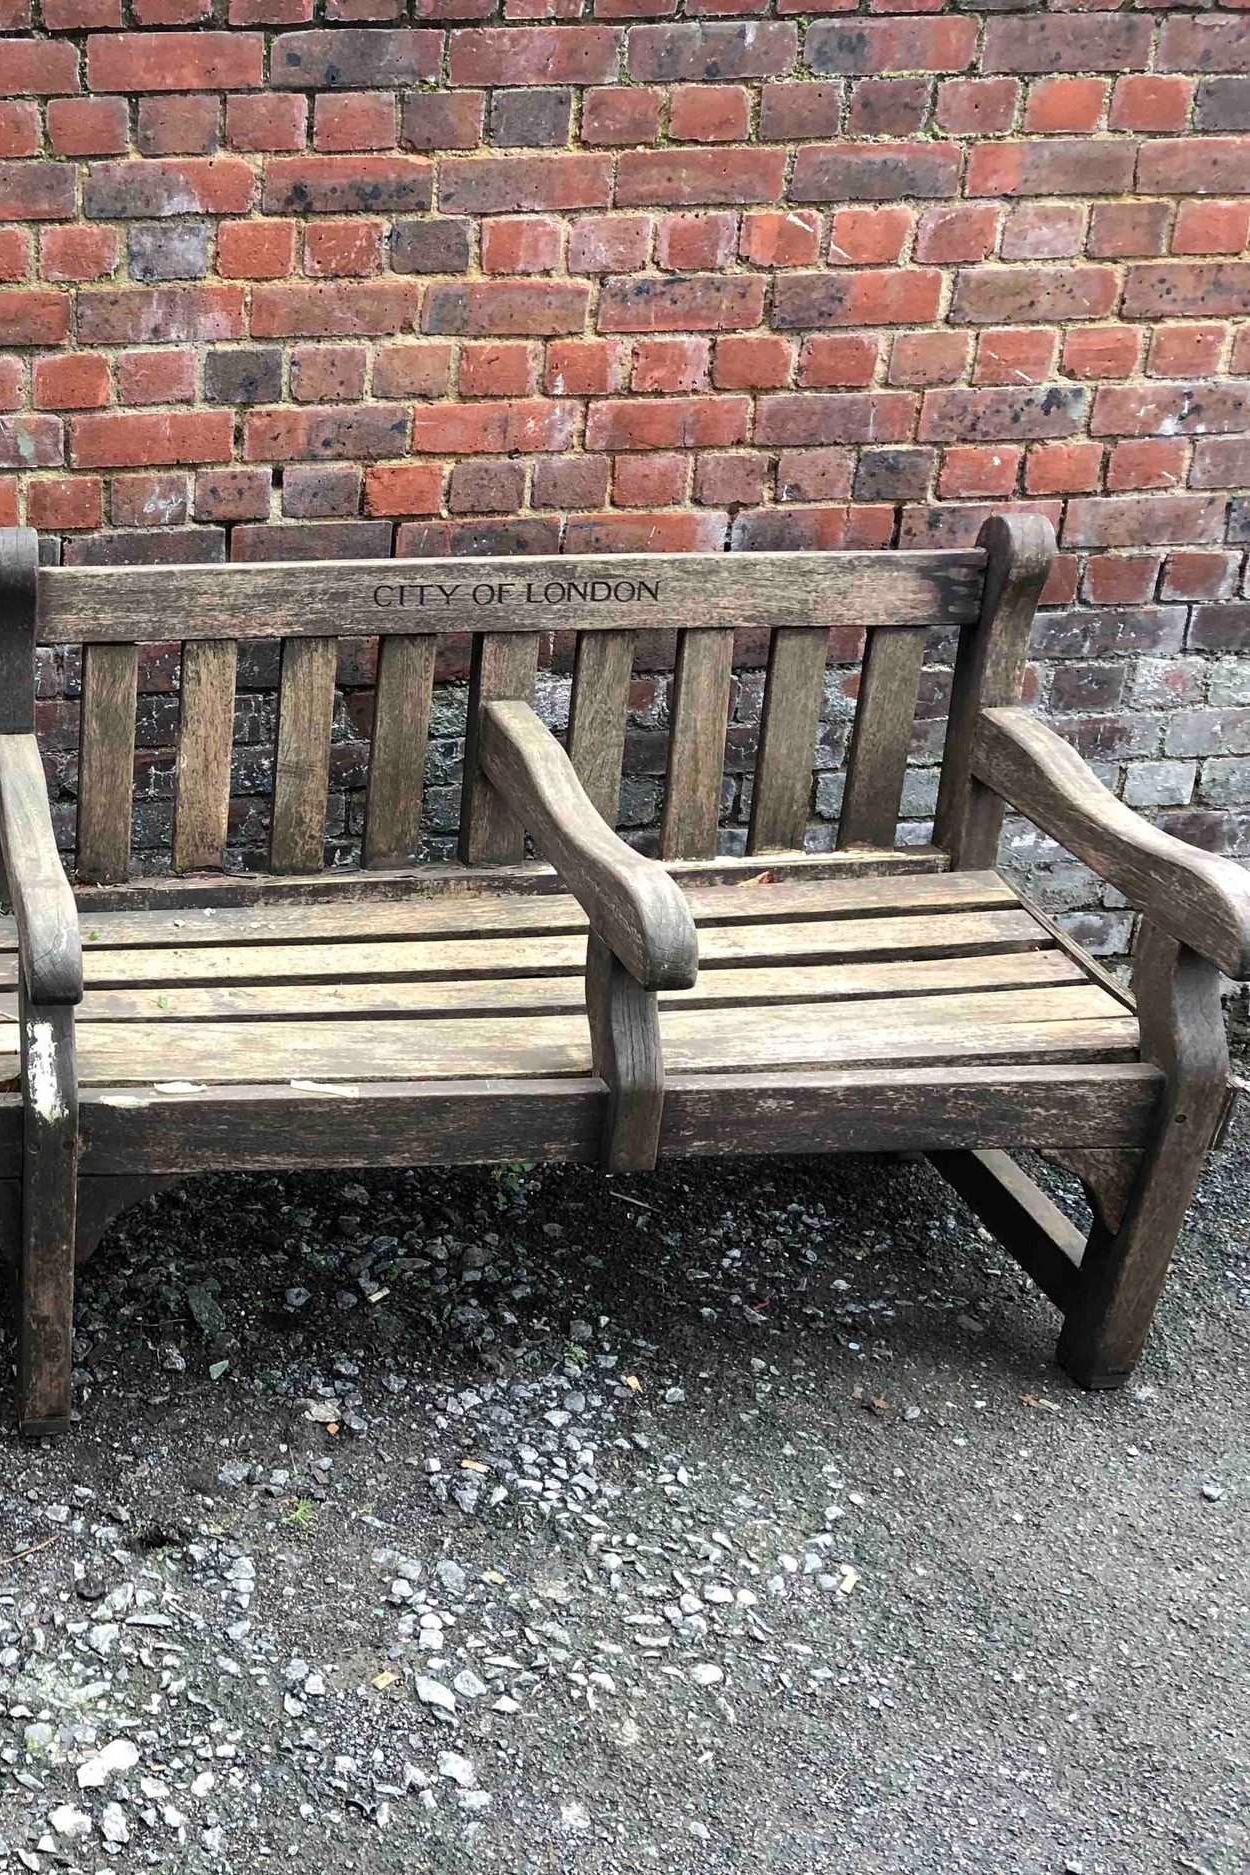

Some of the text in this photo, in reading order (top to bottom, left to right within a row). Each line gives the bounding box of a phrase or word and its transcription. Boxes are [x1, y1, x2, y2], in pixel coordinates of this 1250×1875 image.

[373, 580, 662, 607] CITY OF LONDON
